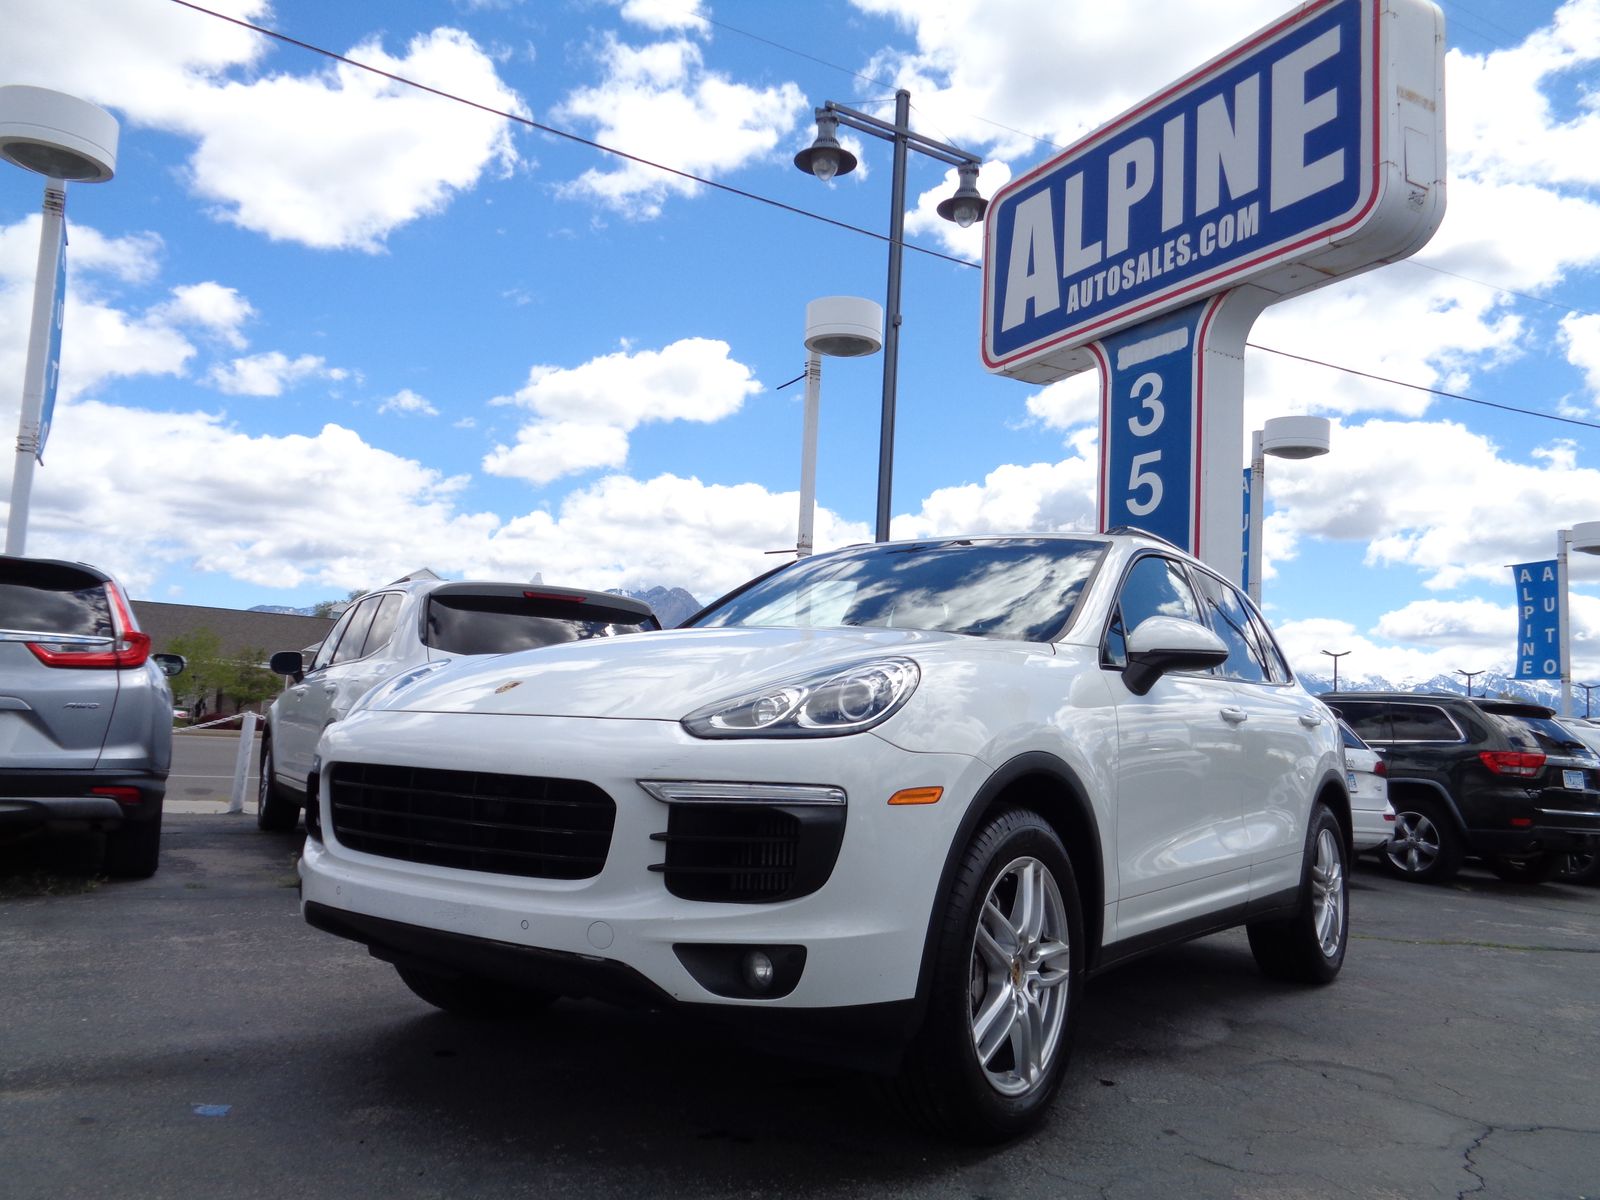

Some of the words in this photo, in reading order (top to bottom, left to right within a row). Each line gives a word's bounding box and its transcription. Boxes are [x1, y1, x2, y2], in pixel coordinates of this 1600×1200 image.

[1001, 24, 1345, 333] ALPINE
[1066, 201, 1260, 315] AUTOSALES.COM
[1520, 568, 1535, 675] ALPINE
[1542, 566, 1557, 675] AUTO
